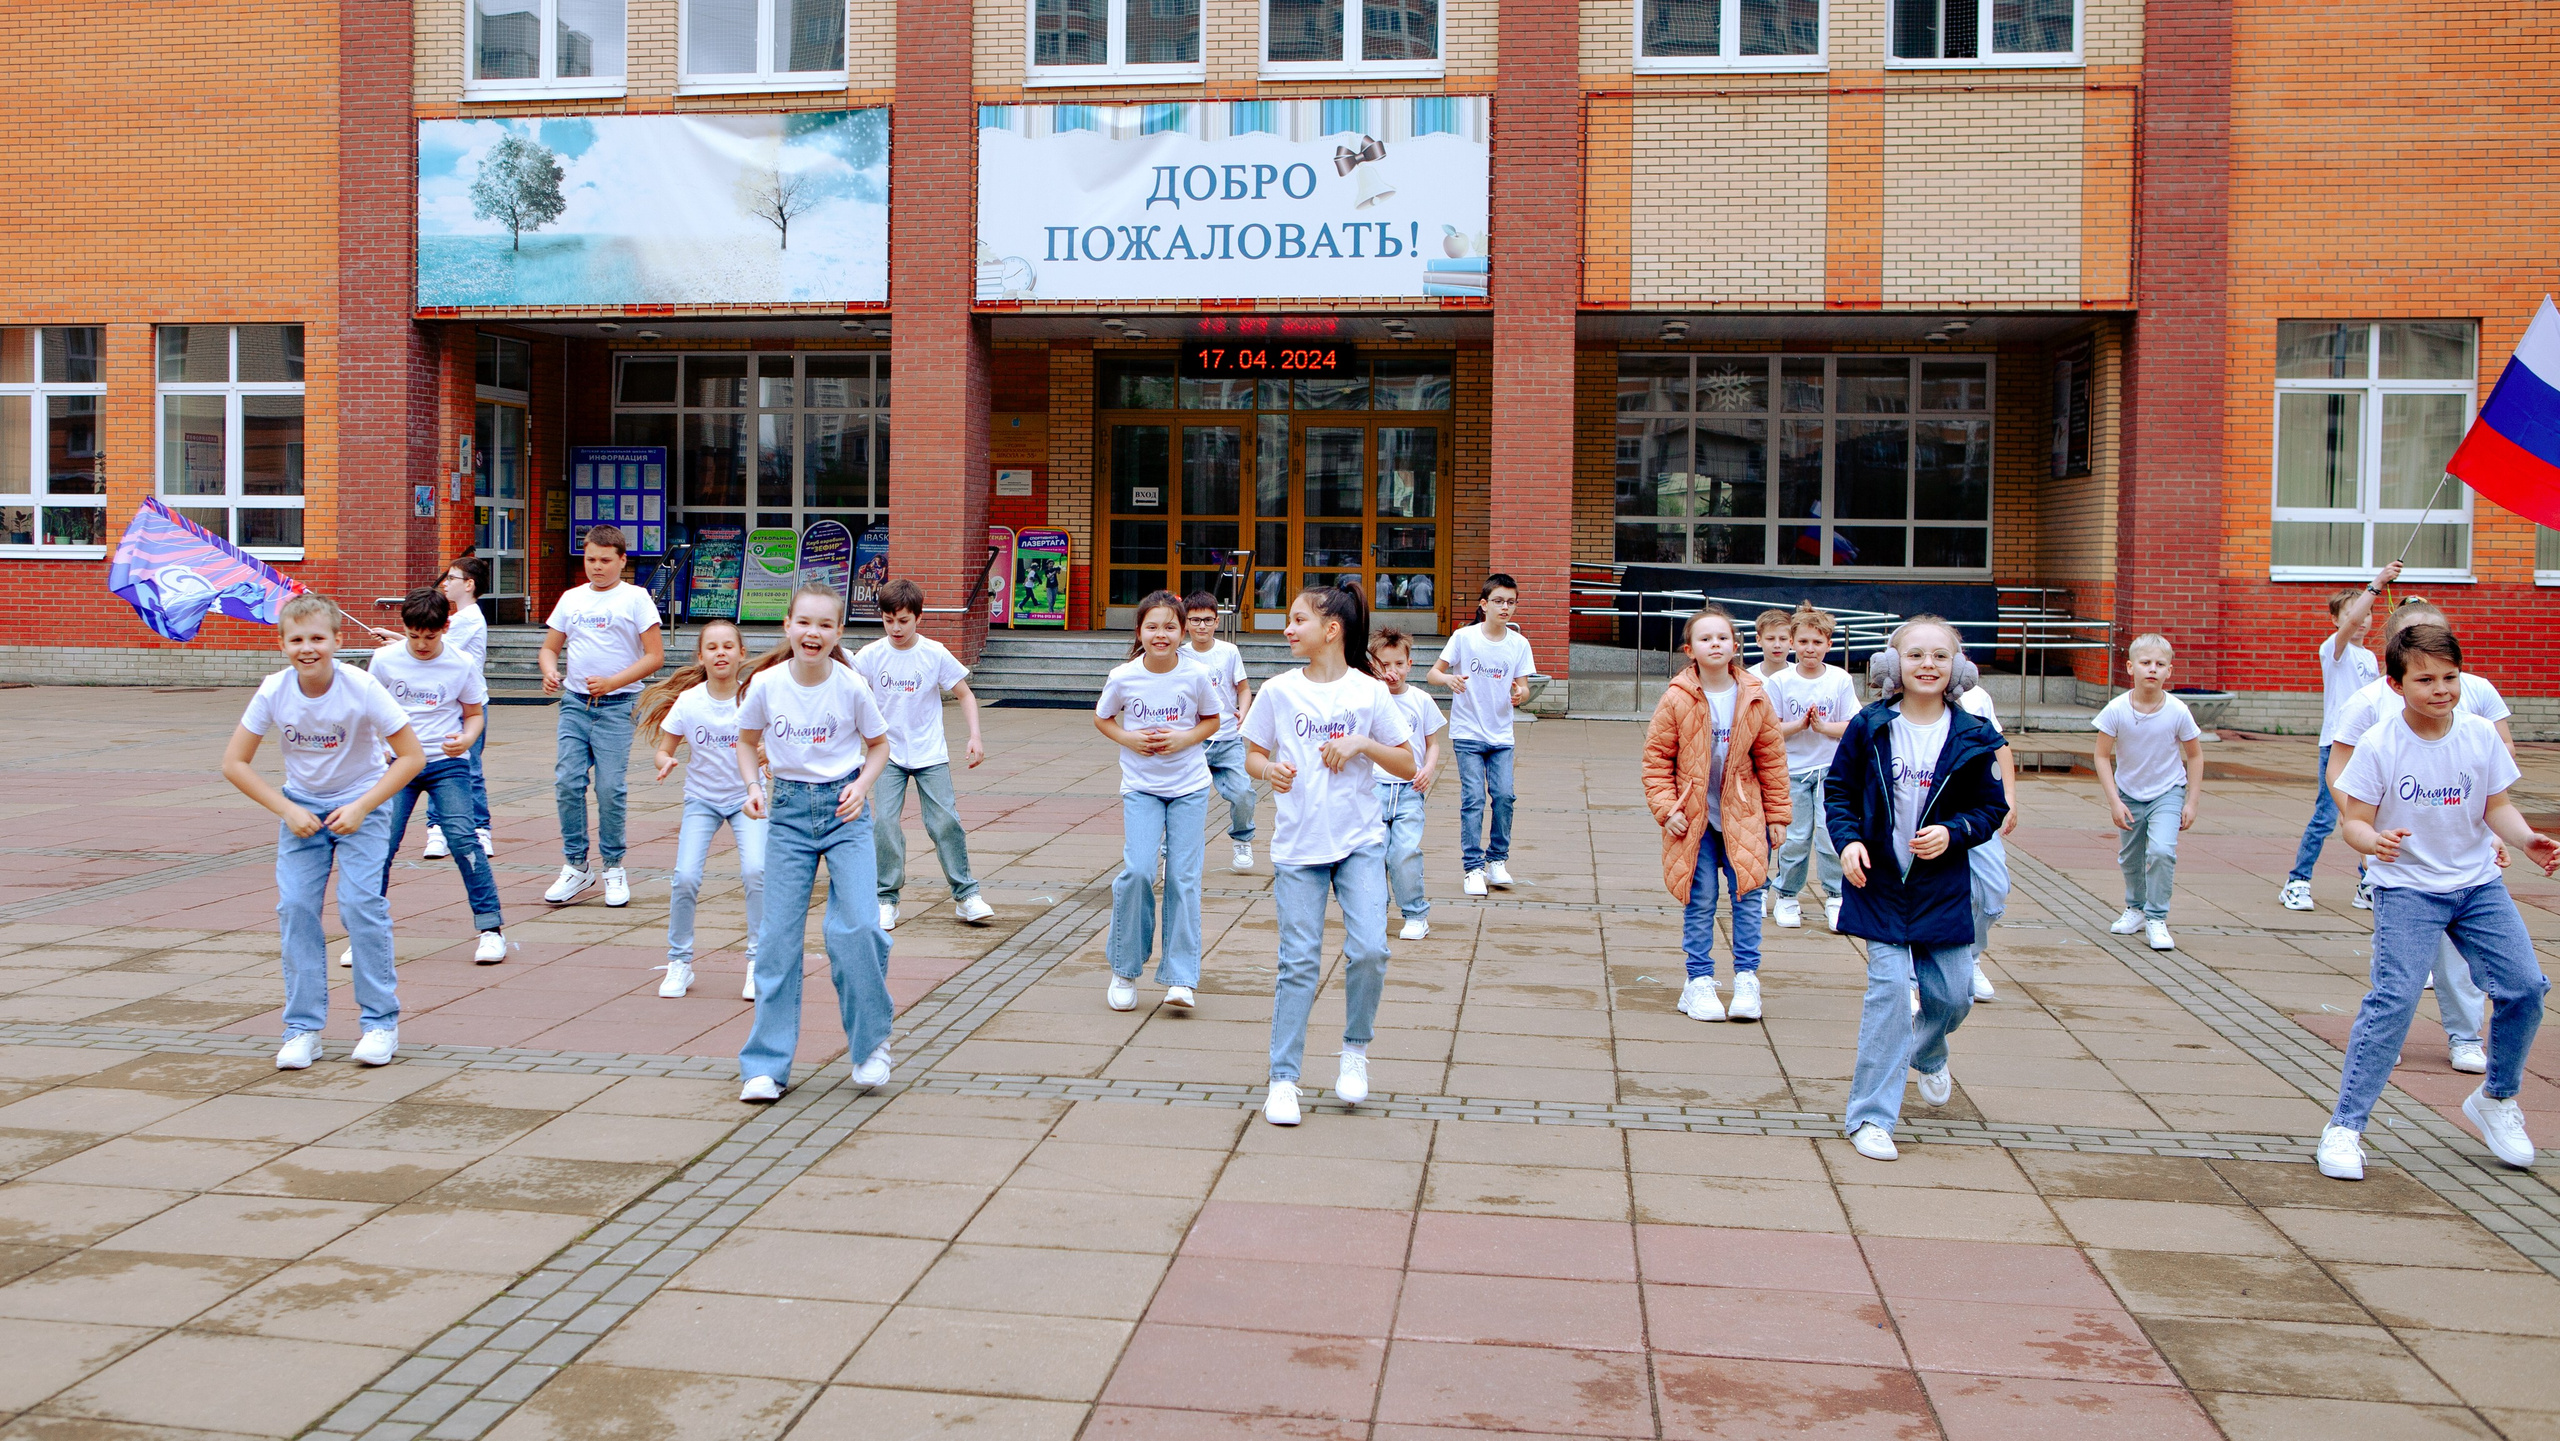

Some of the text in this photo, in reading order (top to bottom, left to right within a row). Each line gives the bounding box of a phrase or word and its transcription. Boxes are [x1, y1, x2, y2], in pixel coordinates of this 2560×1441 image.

[1146, 162, 1317, 211] ДОБРО
[1043, 221, 1420, 262] ПОЖАЛОВАТЬ!
[1198, 349, 1337, 370] 17.04.2024
[588, 454, 648, 462] ИНФОРМАЦИЯ
[1135, 490, 1157, 500] ВХОД
[1021, 539, 1066, 548] ЛАЗЕРТАГА
[1132, 698, 1179, 720] Орлята
[284, 724, 337, 745] Орлята
[774, 714, 827, 741] Орлята
[1294, 712, 1345, 739] Орлята
[2399, 774, 2461, 803] Орлята
[2414, 796, 2461, 807] РОССИИ
